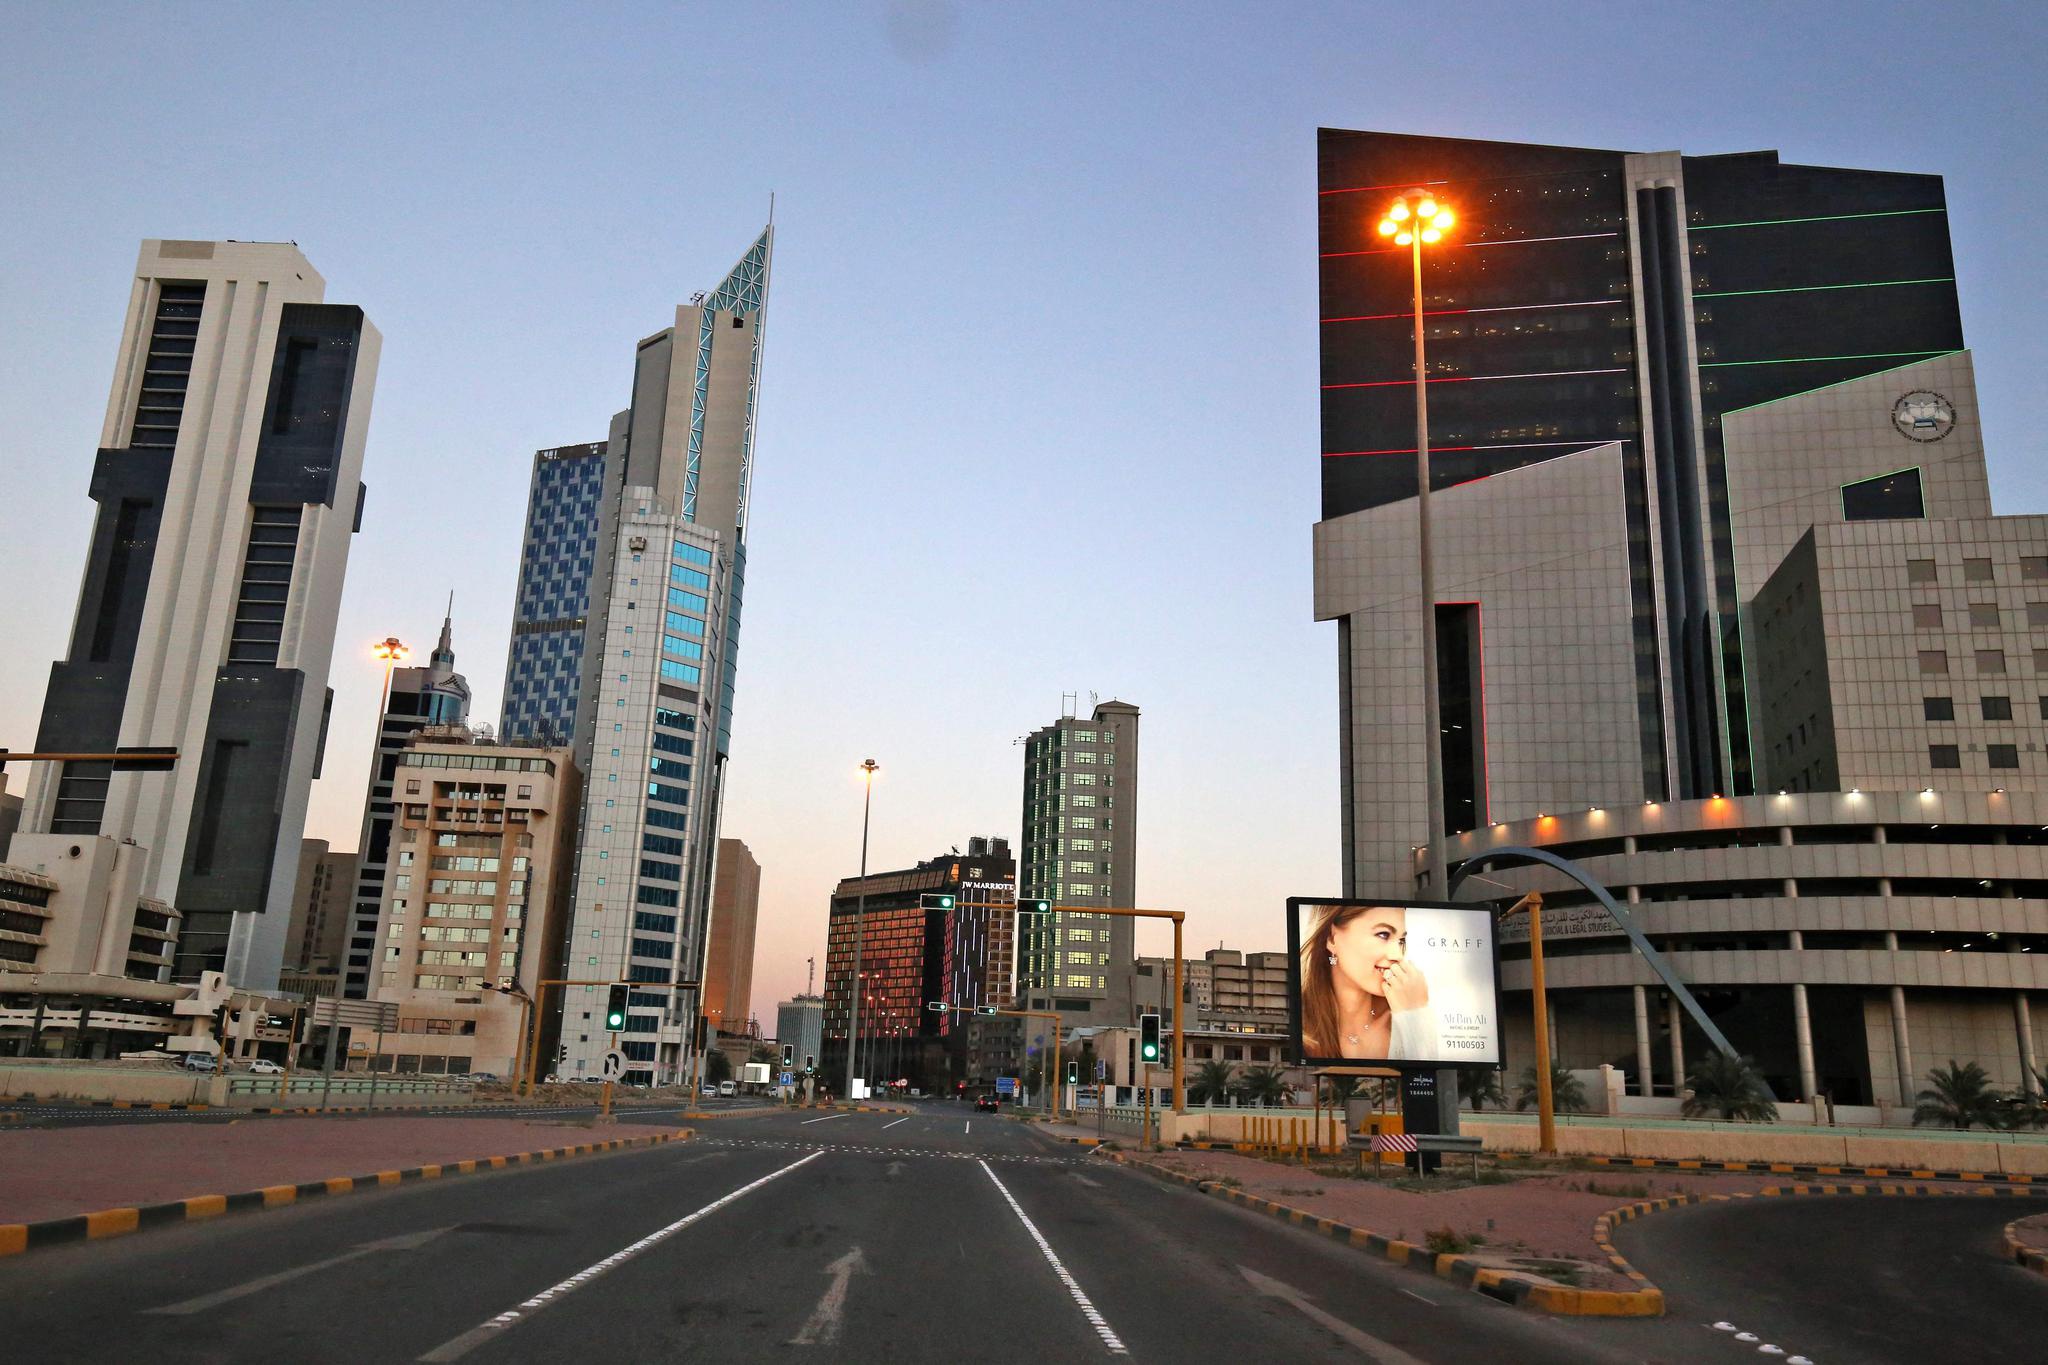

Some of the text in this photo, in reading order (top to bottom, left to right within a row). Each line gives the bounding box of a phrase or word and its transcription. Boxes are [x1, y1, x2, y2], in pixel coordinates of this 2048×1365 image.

[962, 881, 1015, 890] JW MARRIOTT
[1569, 909, 1593, 924] الكويت
[1570, 923, 1587, 934] LEGAL
[1588, 922, 1611, 932] STUDIES
[1427, 937, 1482, 948] GRAFF
[1474, 1014, 1487, 1024] Ali
[1446, 1040, 1485, 1049] 91100503
